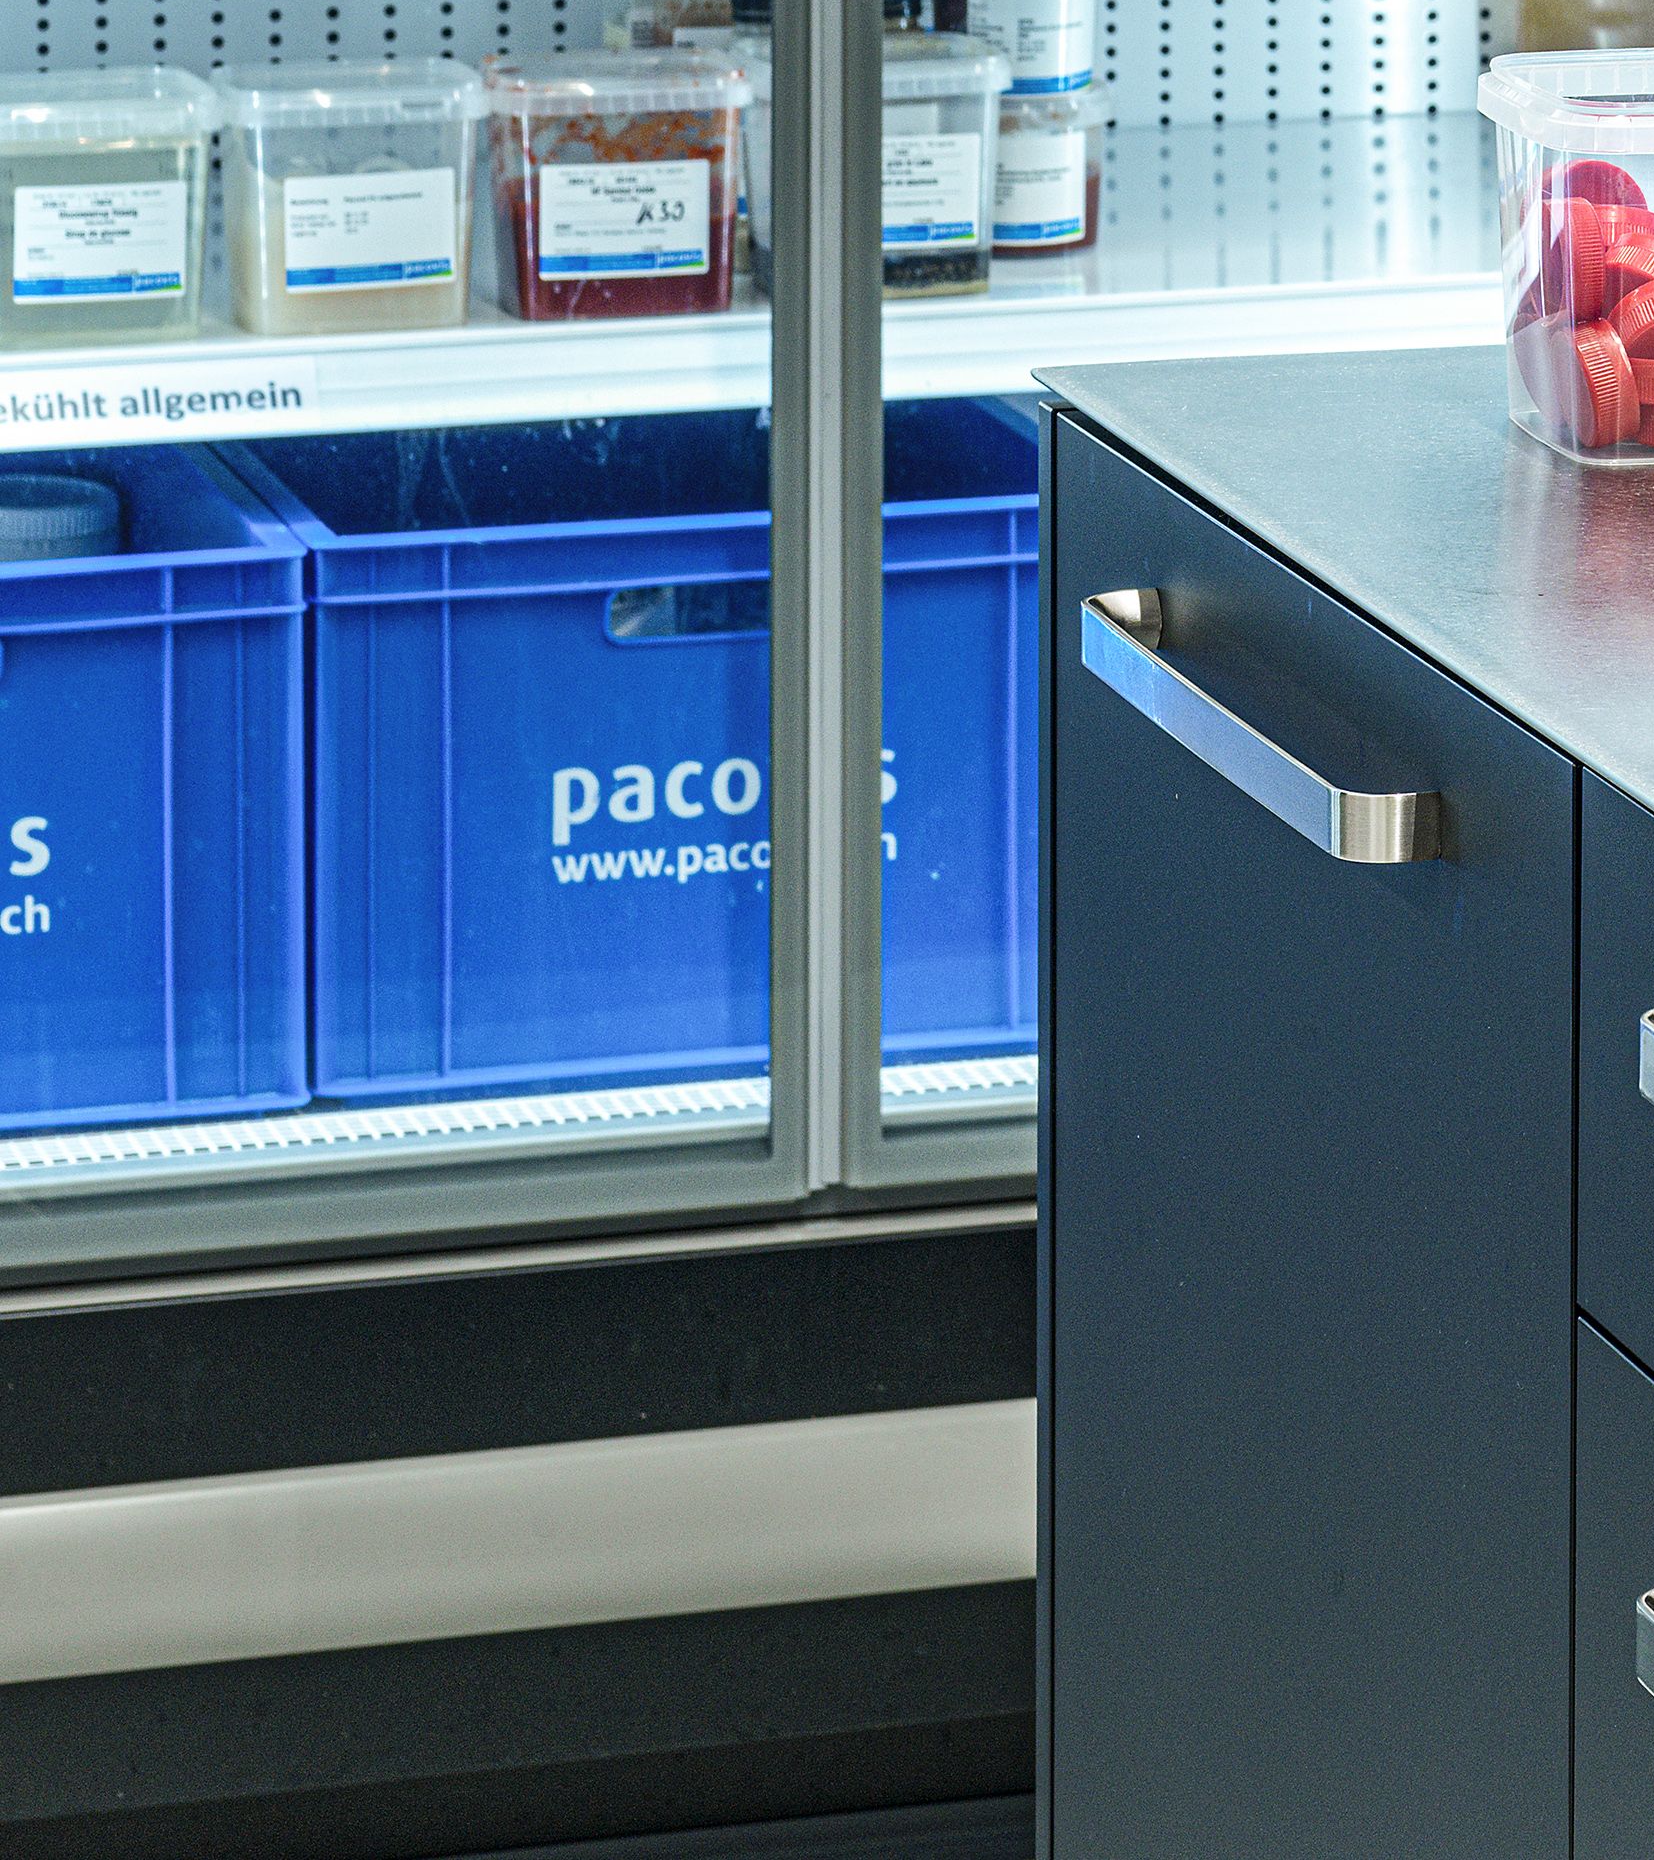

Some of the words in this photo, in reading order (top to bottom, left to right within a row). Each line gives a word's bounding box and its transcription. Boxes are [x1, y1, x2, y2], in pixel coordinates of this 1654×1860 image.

[120, 381, 303, 421] allgemein
[552, 748, 898, 846] paco
[551, 831, 898, 884] www.paco
